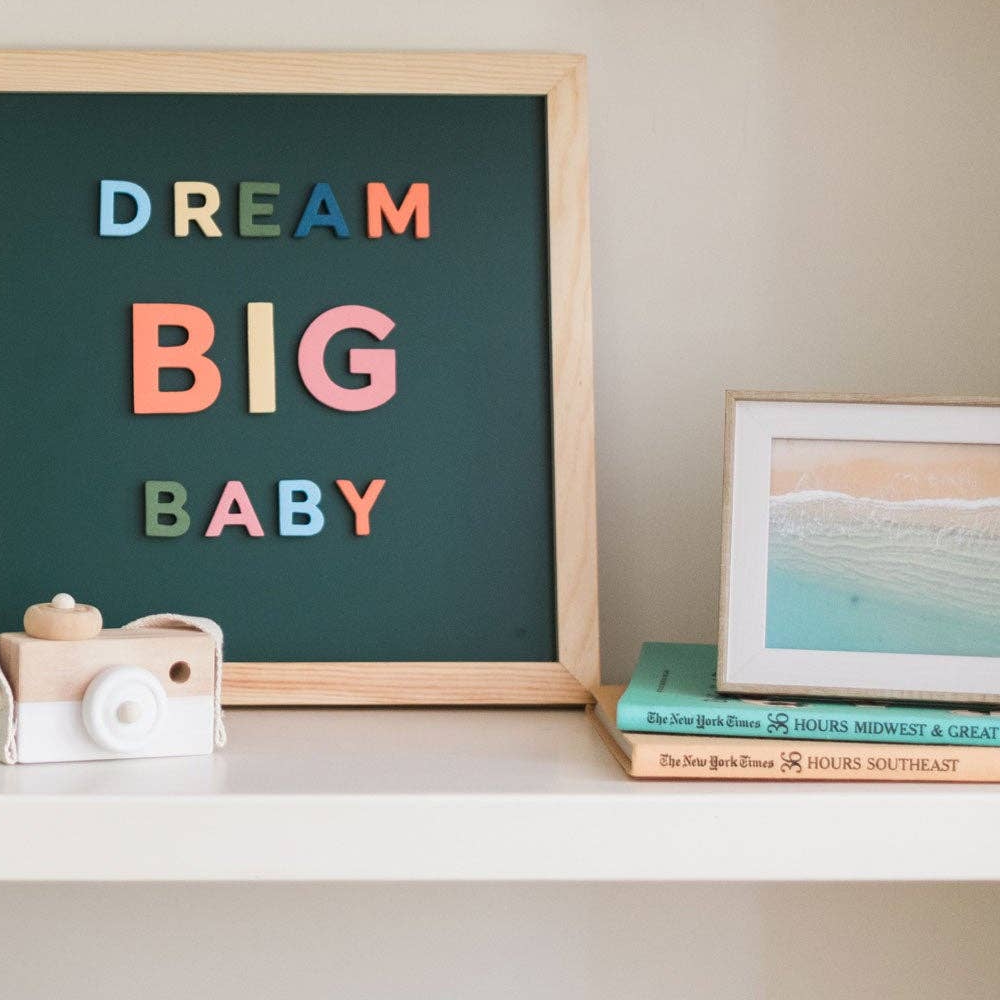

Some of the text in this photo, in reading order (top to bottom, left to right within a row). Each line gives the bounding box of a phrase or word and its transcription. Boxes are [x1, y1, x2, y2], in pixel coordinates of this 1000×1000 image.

[100, 180, 430, 238] DREAM
[132, 302, 397, 414] BIG
[144, 479, 386, 537] BABY
[647, 711, 668, 725] The
[670, 713, 694, 726] New
[696, 714, 724, 729] York
[726, 715, 761, 728] Times
[794, 718, 848, 733] HOURS
[854, 720, 927, 736] MIDWEST
[931, 724, 943, 737] &
[948, 724, 1000, 739] GREAT
[659, 753, 680, 767] The
[682, 754, 707, 767] New
[709, 755, 737, 770] York
[739, 754, 774, 768] Times
[807, 757, 861, 770] HOURS
[867, 757, 960, 772] SOUTHEAST
